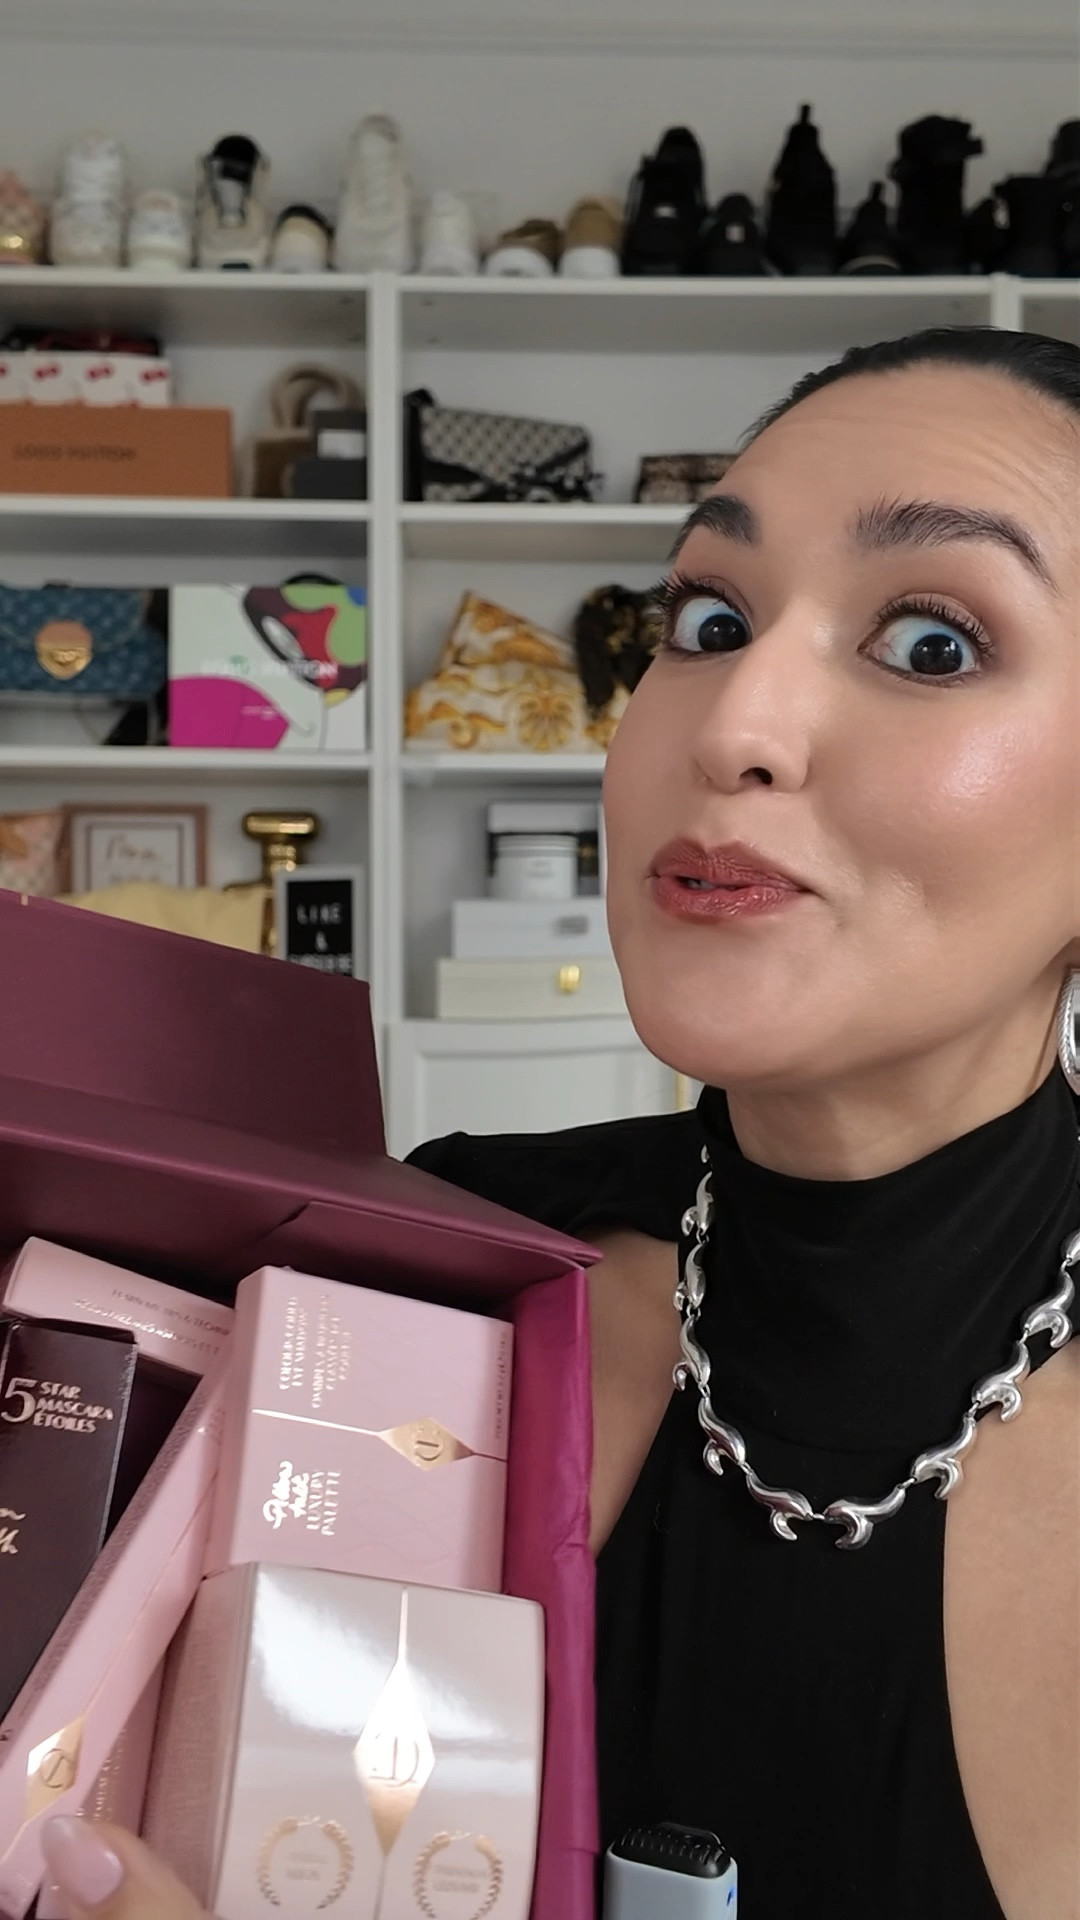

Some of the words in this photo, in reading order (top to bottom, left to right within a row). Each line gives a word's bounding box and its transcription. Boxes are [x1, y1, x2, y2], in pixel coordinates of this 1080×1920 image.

[1, 1377, 38, 1423] 5
[39, 1381, 82, 1399] STAR
[36, 1397, 114, 1421] MASCARA
